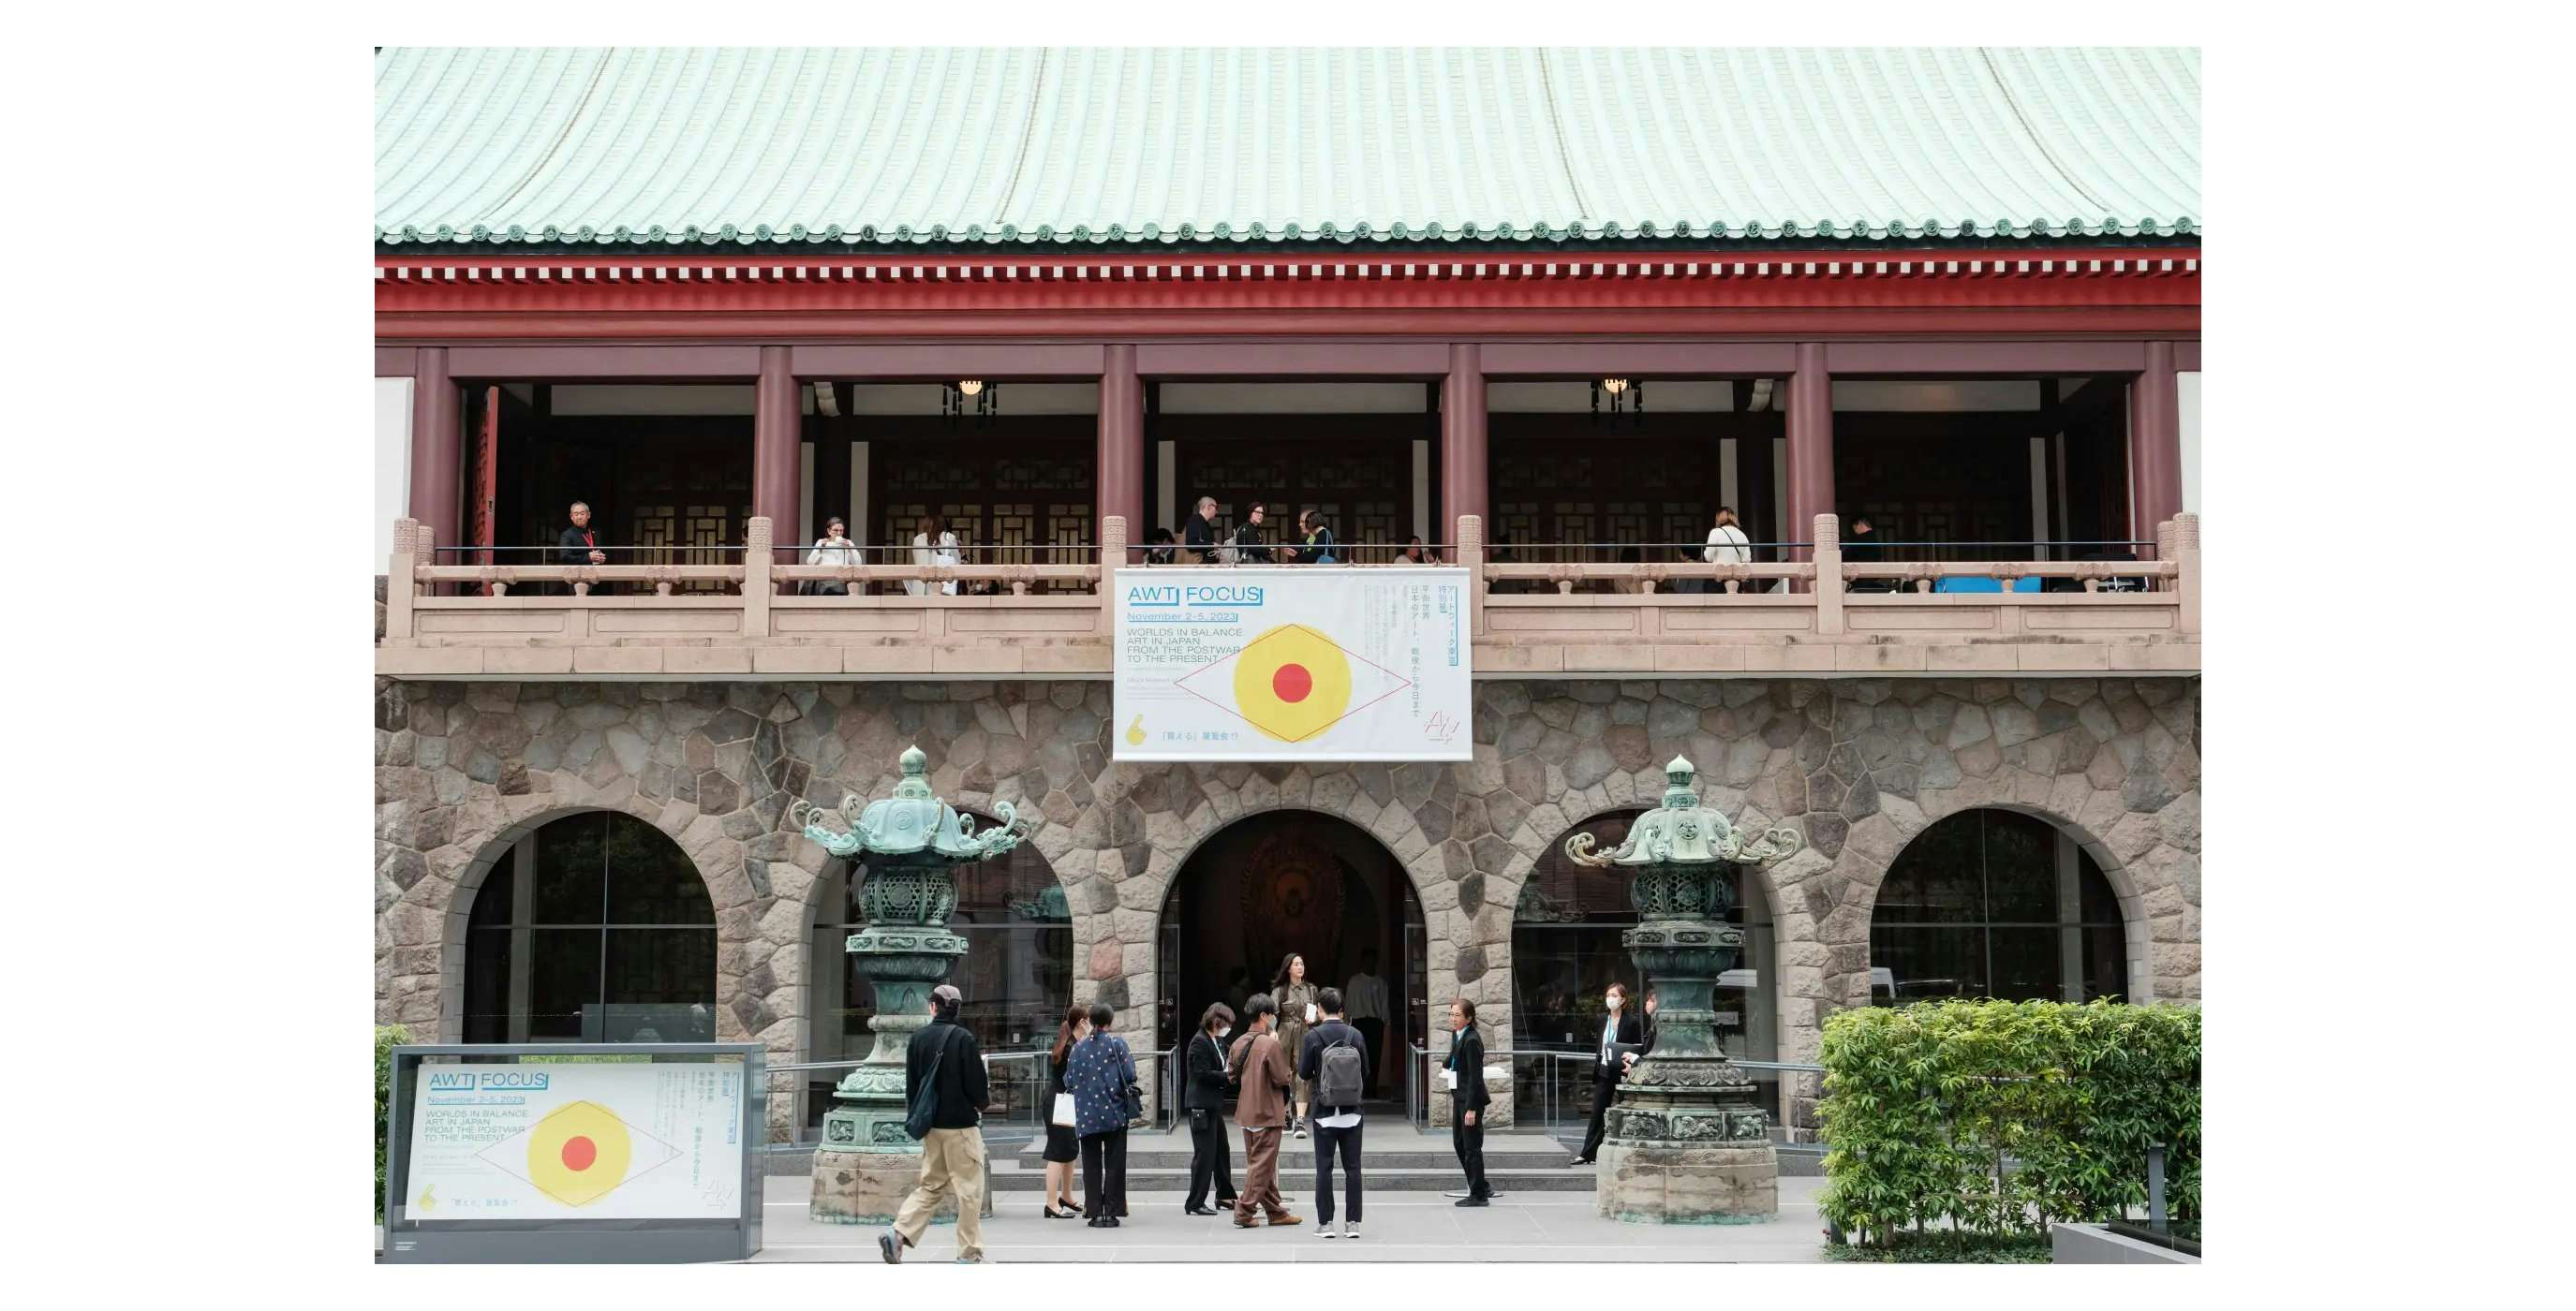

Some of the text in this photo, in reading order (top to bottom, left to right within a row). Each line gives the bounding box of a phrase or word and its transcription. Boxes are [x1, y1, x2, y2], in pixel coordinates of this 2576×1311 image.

[1128, 586, 1260, 601] AWT FOCUS
[1127, 612, 1181, 622] November
[1210, 612, 1236, 622] 2023
[1127, 628, 1244, 637] WORLDS IN BALANCE
[1127, 637, 1201, 645] ART IN JAPAN
[1127, 645, 1241, 655] FROM THE POSTWAR
[1127, 655, 1219, 663] TO THE PRESENT
[430, 1072, 545, 1086] AWT FOCUS
[427, 1095, 476, 1104] November
[426, 1109, 528, 1118] WORLDS IN BALANCE
[424, 1117, 491, 1126] ART IN JAPAN
[424, 1126, 526, 1134] FROM THE POSTWAR
